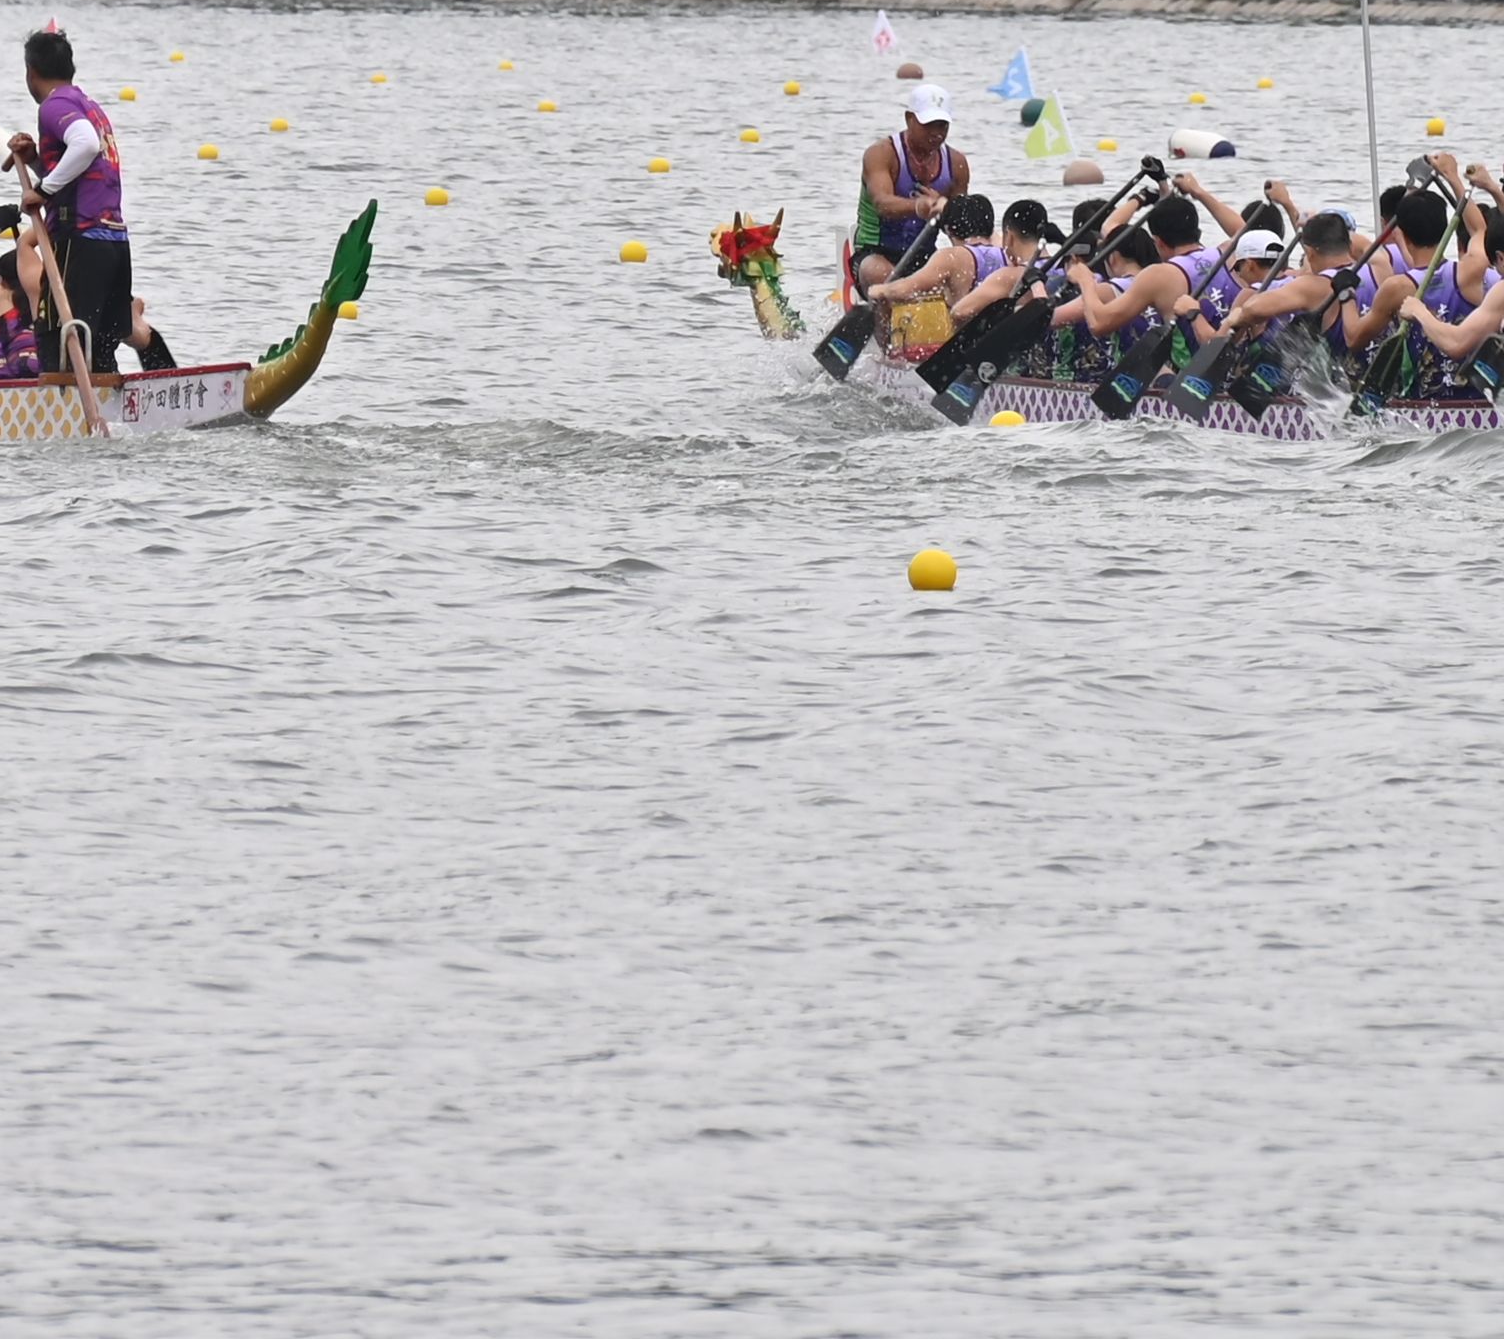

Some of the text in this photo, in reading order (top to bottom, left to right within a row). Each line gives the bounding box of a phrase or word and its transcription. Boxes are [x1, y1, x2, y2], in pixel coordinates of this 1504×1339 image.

[141, 378, 209, 415] 沙田體育會
